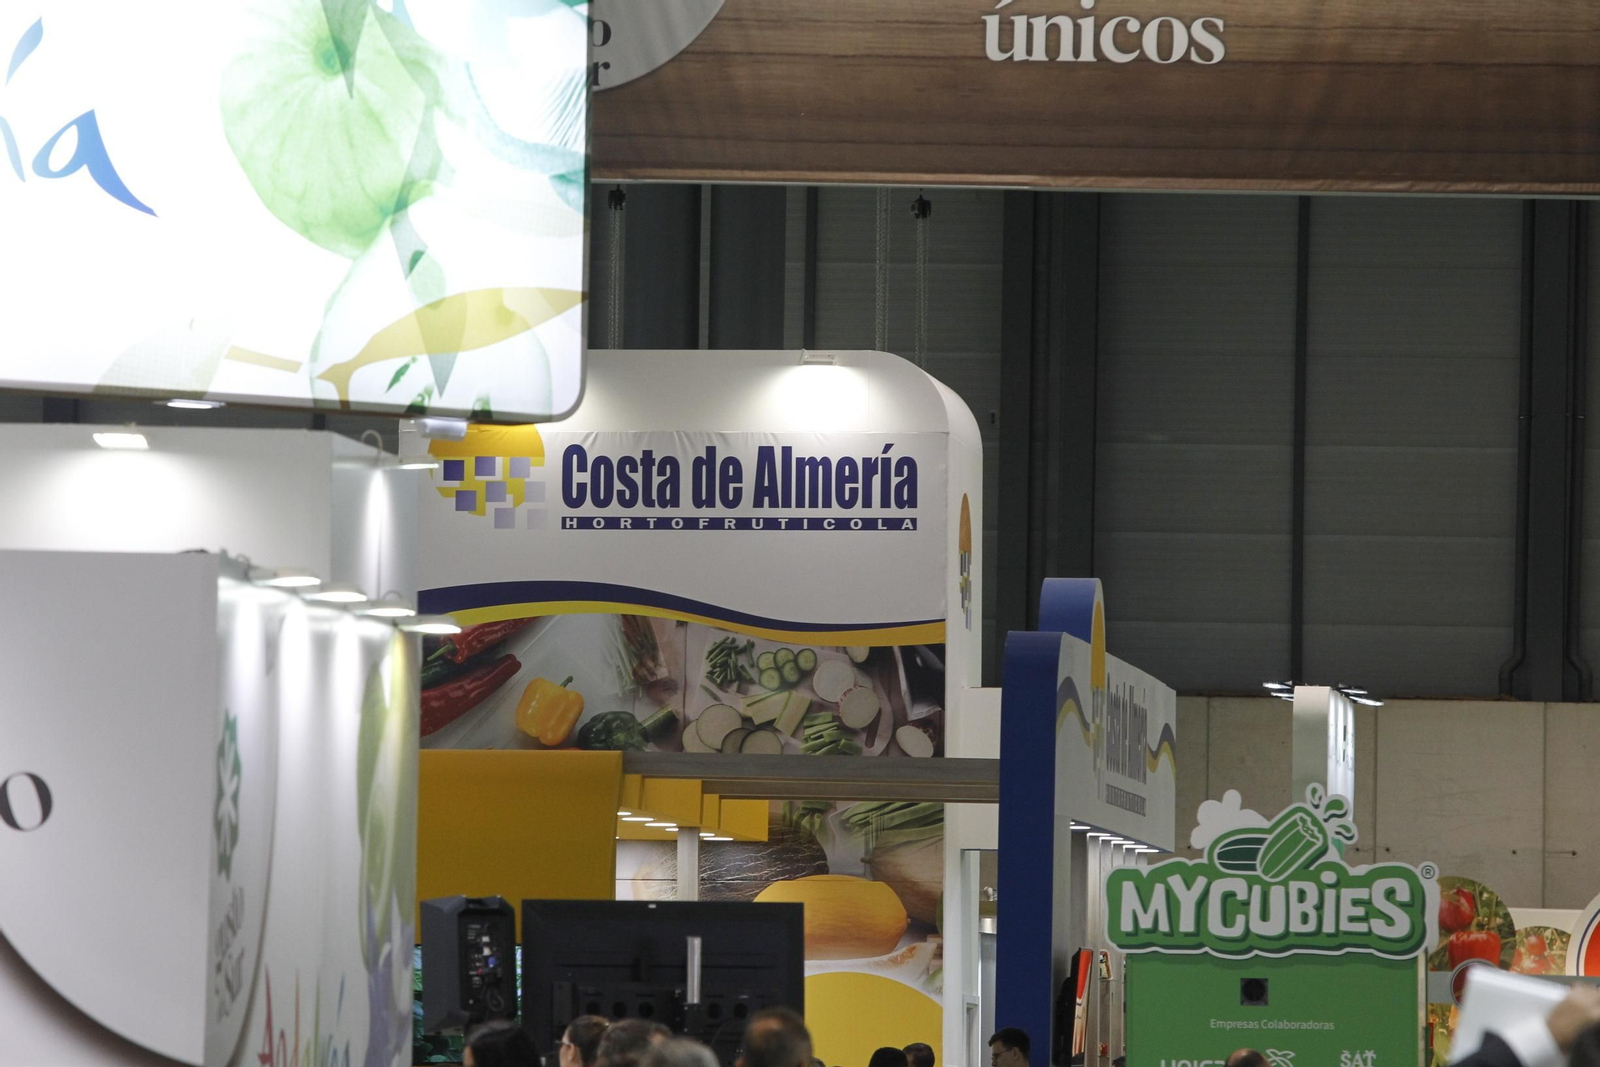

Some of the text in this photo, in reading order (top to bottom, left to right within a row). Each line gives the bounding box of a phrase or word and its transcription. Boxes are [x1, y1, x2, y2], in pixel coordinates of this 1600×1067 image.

[981, 0, 1226, 65] únicos
[562, 443, 918, 509] Costa de Almería
[565, 518, 914, 529] HORTOFRUTICOLA
[1210, 1019, 1335, 1030] Empresas Colaboradoras
